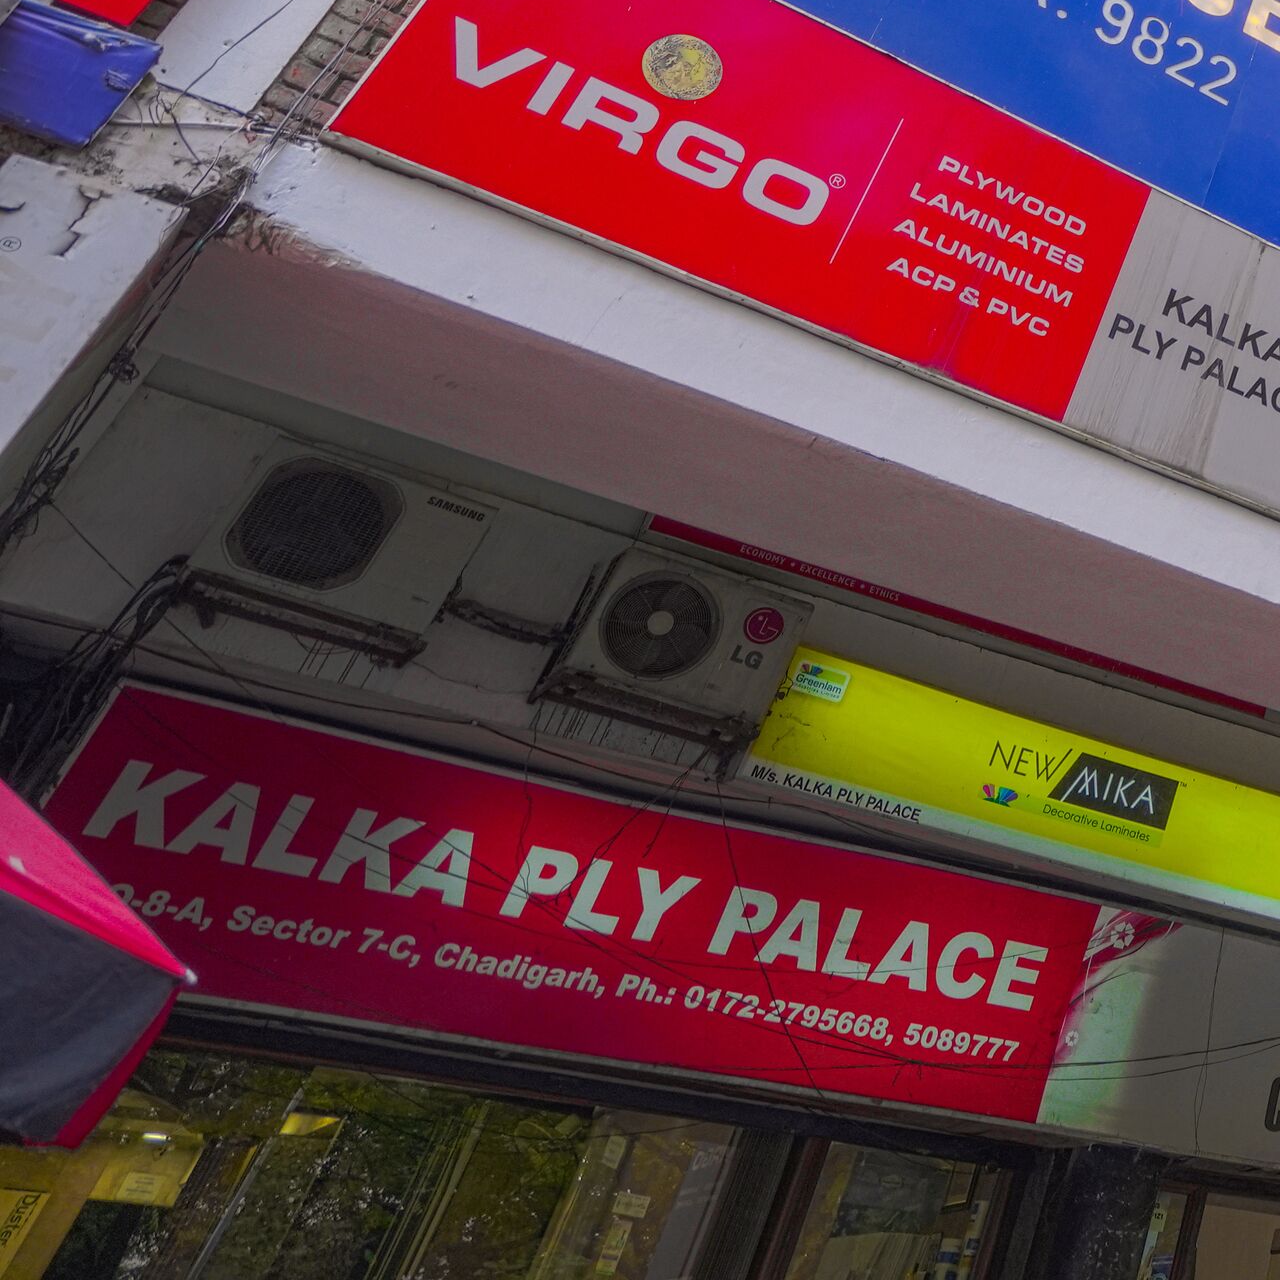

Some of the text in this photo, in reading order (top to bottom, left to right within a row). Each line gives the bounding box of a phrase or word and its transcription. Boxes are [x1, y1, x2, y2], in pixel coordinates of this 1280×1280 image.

[455, 17, 829, 225] VIRGO
[909, 182, 1084, 273] LAMINATES
[938, 156, 1087, 236] PLYWOOD
[887, 257, 1049, 337] ACP & PVC
[893, 219, 1073, 308] ALUMINIUM
[1108, 313, 1177, 360] PLY
[427, 496, 485, 521] SAMSUNG
[740, 544, 900, 603] ECONOMY EXCELLENCE ETHICS
[729, 645, 764, 669] LG
[796, 673, 842, 695] Greenlam
[751, 764, 922, 821] M/s. KALKA PLY PALACE
[989, 740, 1155, 815] NEW MIKA
[1042, 803, 1150, 842] Decorative Laminates
[82, 759, 1049, 1012] KALKA PLY PALACE
[227, 905, 351, 948] Sector
[357, 928, 421, 968] 7-C,
[433, 942, 606, 1000] Chadigarh,
[616, 972, 676, 1006] Ph.:
[683, 985, 895, 1048] 0172-2795668,
[902, 1022, 1020, 1063] 5089777
